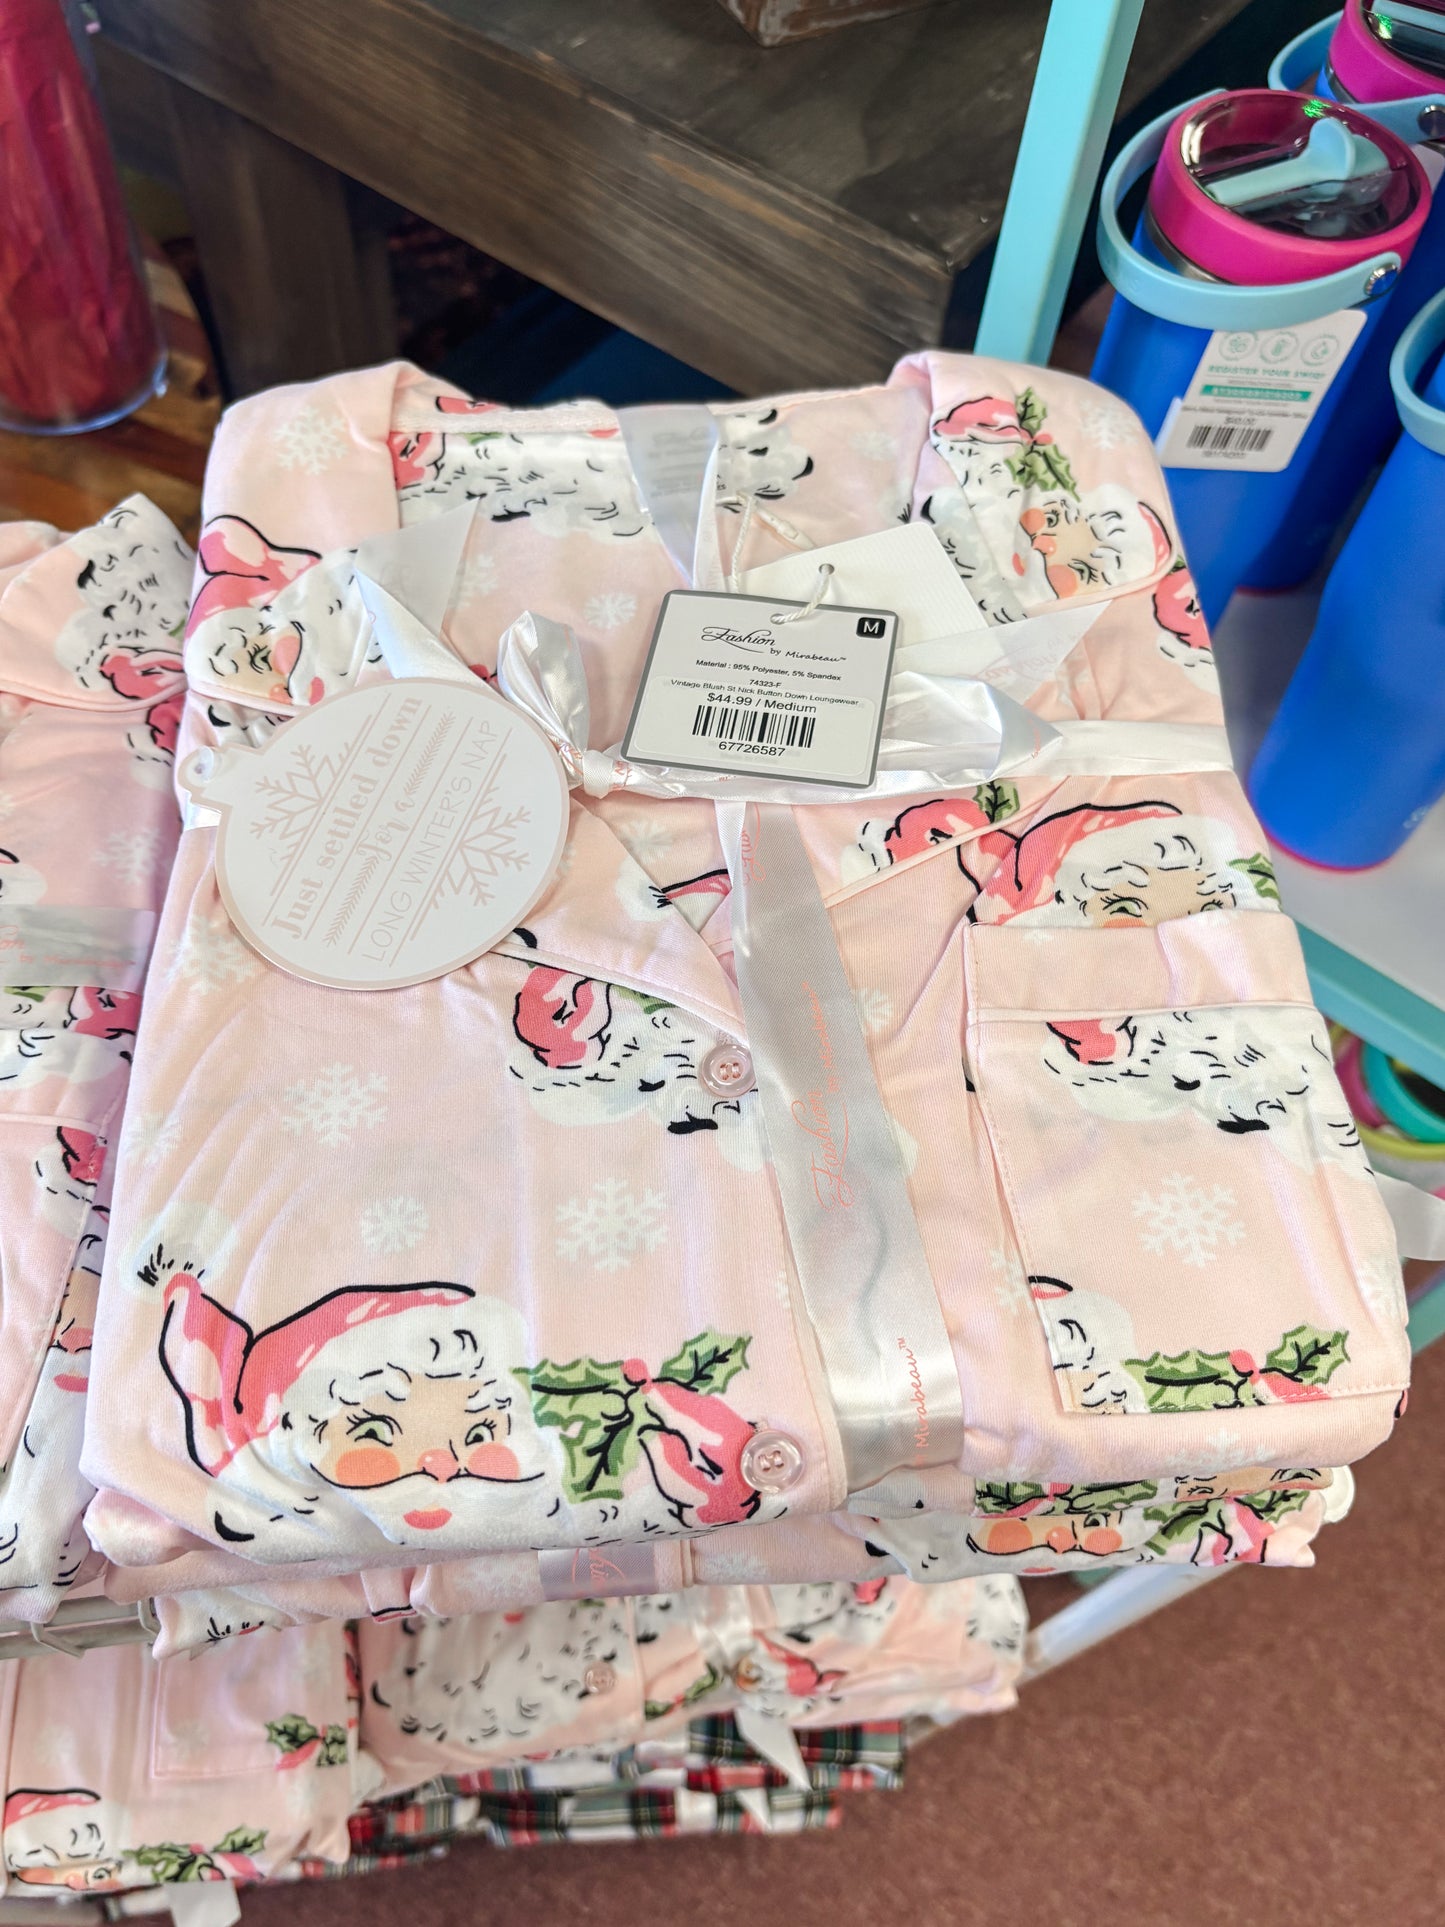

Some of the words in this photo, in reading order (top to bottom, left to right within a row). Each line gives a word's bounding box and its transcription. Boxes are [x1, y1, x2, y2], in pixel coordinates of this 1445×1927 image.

[862, 621, 879, 635] M
[700, 626, 776, 654] Fashion
[769, 647, 782, 656] by
[695, 659, 728, 670] Material
[732, 663, 751, 672] 95%
[752, 666, 791, 678] Polyester,
[791, 670, 806, 678] 5%
[806, 672, 842, 682] Spandex
[670, 679, 701, 689] Vintage
[702, 682, 726, 691] Blush
[726, 685, 737, 693] St
[737, 686, 756, 695] Nick
[756, 688, 784, 699] Button
[784, 691, 809, 701] Down
[809, 694, 860, 707] Loungewear
[749, 679, 782, 689] 74323-F
[706, 692, 753, 707] $44.99
[763, 699, 818, 714] Medium
[717, 740, 787, 757] 67726587
[394, 796, 416, 813] a
[271, 876, 325, 940] Just
[315, 772, 380, 870] settled
[365, 696, 424, 768] down
[361, 889, 413, 962] LONG
[460, 719, 498, 771] NAP
[790, 1090, 856, 1213] Fashion
